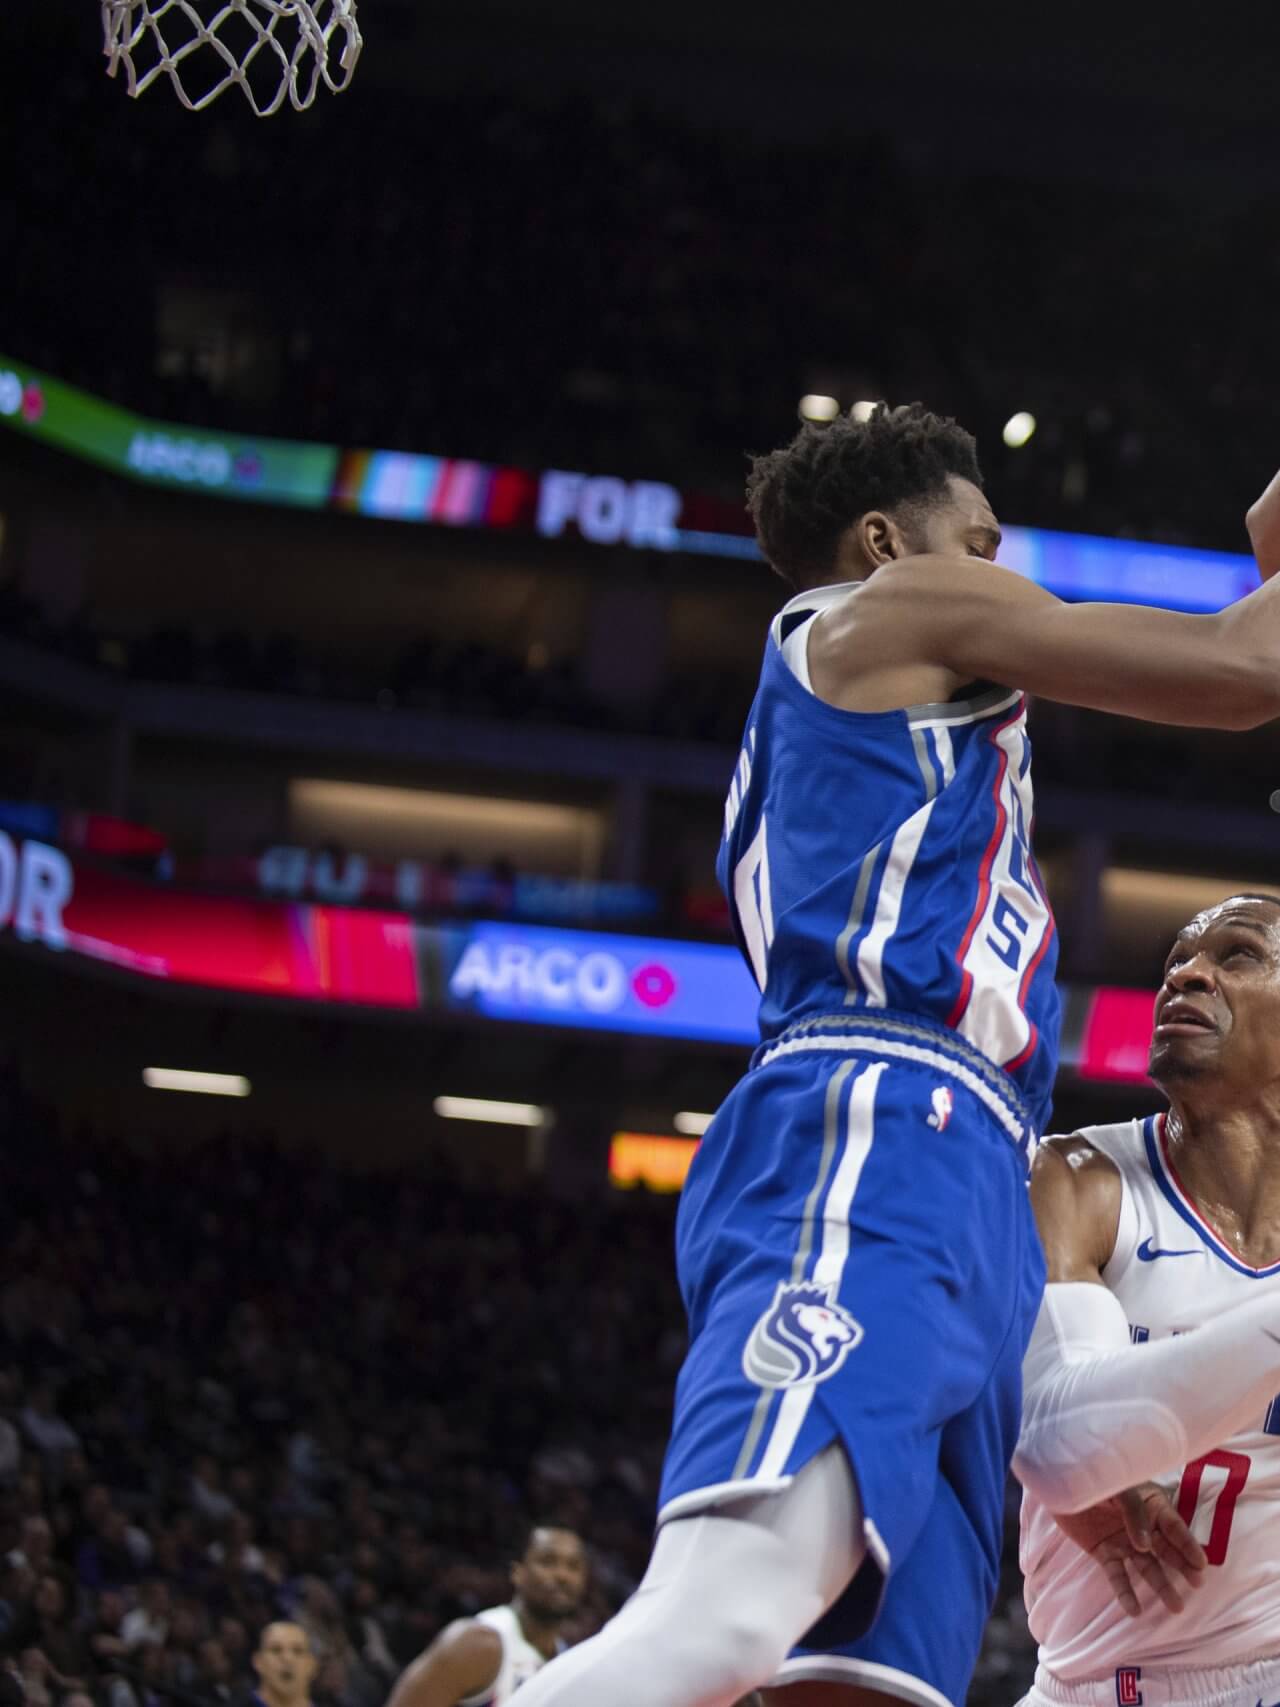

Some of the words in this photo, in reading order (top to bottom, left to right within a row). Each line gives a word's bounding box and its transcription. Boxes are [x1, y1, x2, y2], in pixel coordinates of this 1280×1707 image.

[537, 469, 683, 552] FOR
[449, 942, 627, 1014] ARCO
[1176, 1448, 1252, 1566] 0
